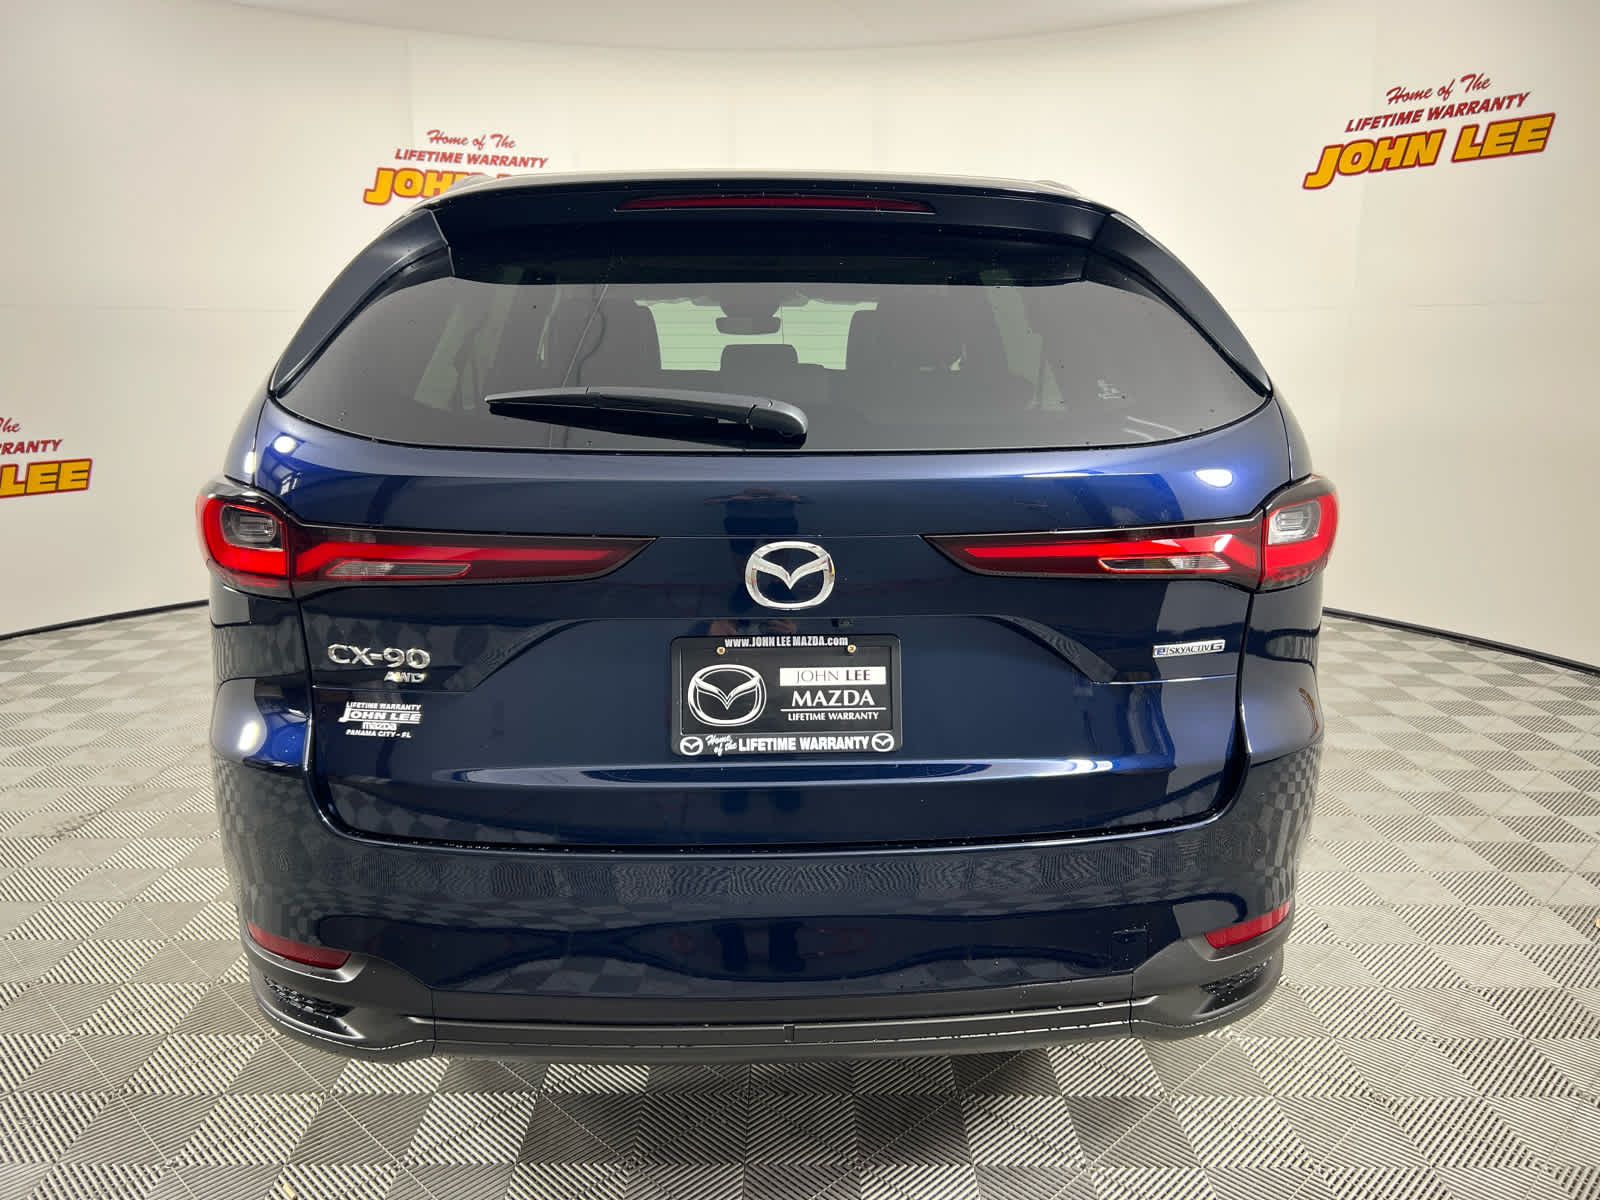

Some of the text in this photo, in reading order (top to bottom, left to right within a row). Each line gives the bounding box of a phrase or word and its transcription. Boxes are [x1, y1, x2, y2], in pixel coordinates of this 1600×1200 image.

[1386, 72, 1491, 105] Home of The
[1344, 91, 1531, 133] LIFETIME WARRANTY
[427, 129, 516, 150] Home of The
[394, 148, 549, 168] LIFETIME WARRANTY
[1303, 112, 1556, 190] JOHN LEE
[363, 167, 470, 206] JOH
[0, 439, 64, 455] RANTY
[0, 457, 93, 499] LEE
[328, 643, 431, 669] CX-90
[384, 671, 426, 683] AWD
[796, 669, 871, 684] JOHN LEE
[346, 701, 422, 711] LIFETIME WARRANTY
[792, 689, 875, 707] MAZDA
[338, 706, 422, 723] JOHN LEE
[788, 711, 879, 721] LIFETIME WARRANTY
[346, 729, 377, 737] PANAMA
[705, 734, 733, 746] Home
[714, 743, 724, 757] of
[738, 735, 870, 752] LIFETIME WARRANTY
